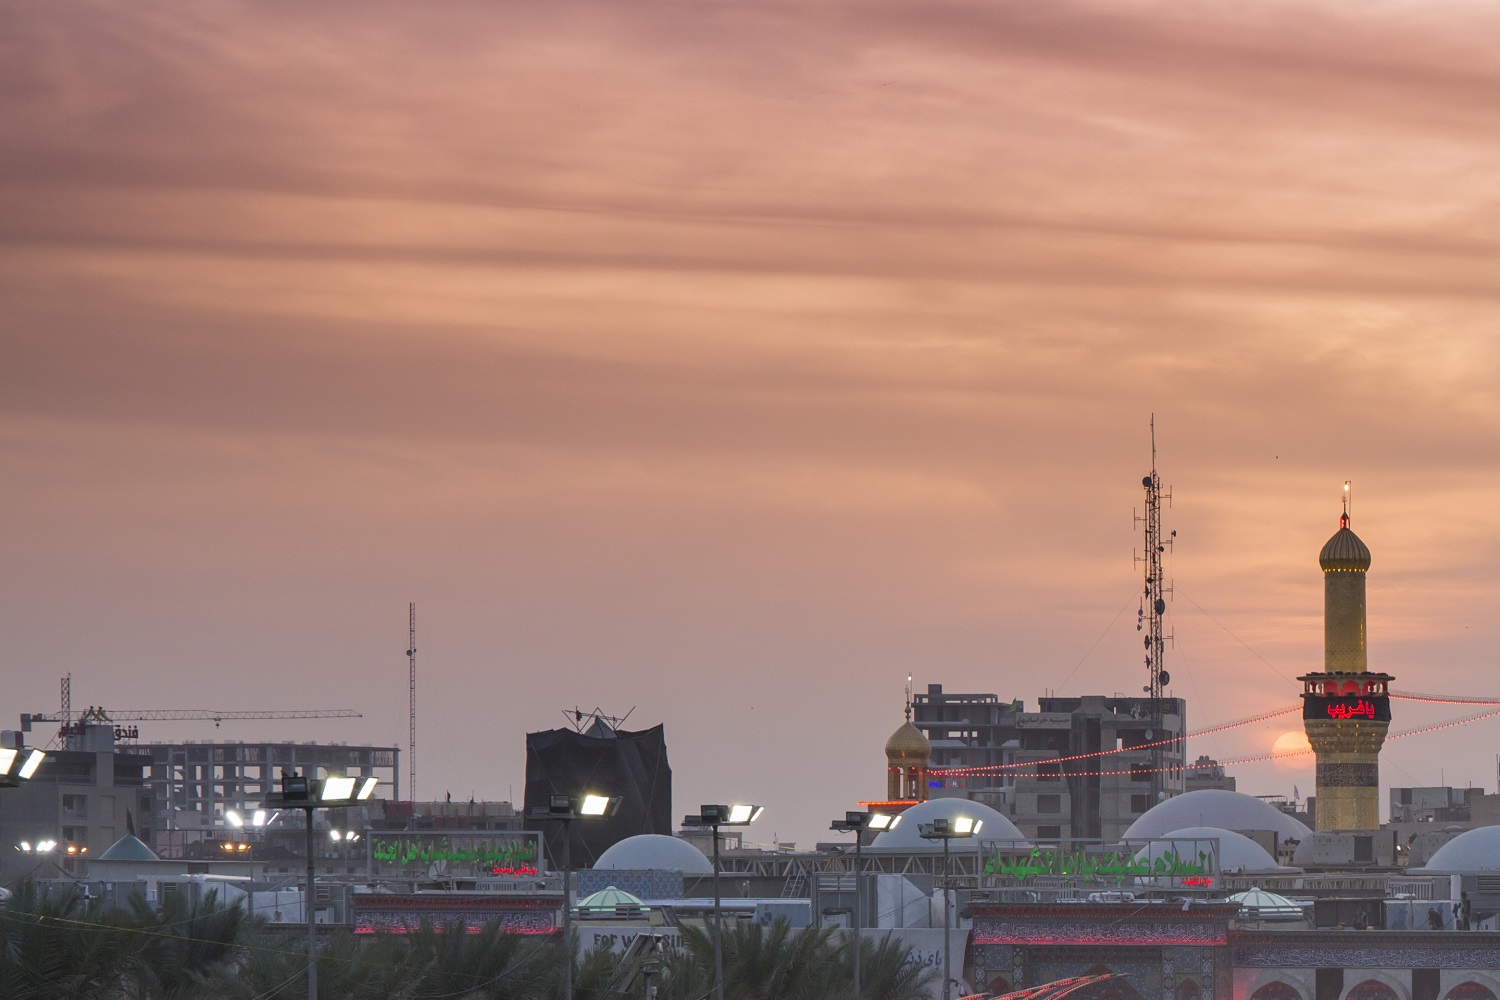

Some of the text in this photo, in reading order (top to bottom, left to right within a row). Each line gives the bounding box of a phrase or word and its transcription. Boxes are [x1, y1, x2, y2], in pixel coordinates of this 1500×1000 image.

[1327, 699, 1365, 720] غريب
[114, 724, 139, 741] فندق
[984, 845, 1057, 881] الشهداء
[1097, 850, 1150, 883] عليك
[1154, 849, 1213, 882] السلام
